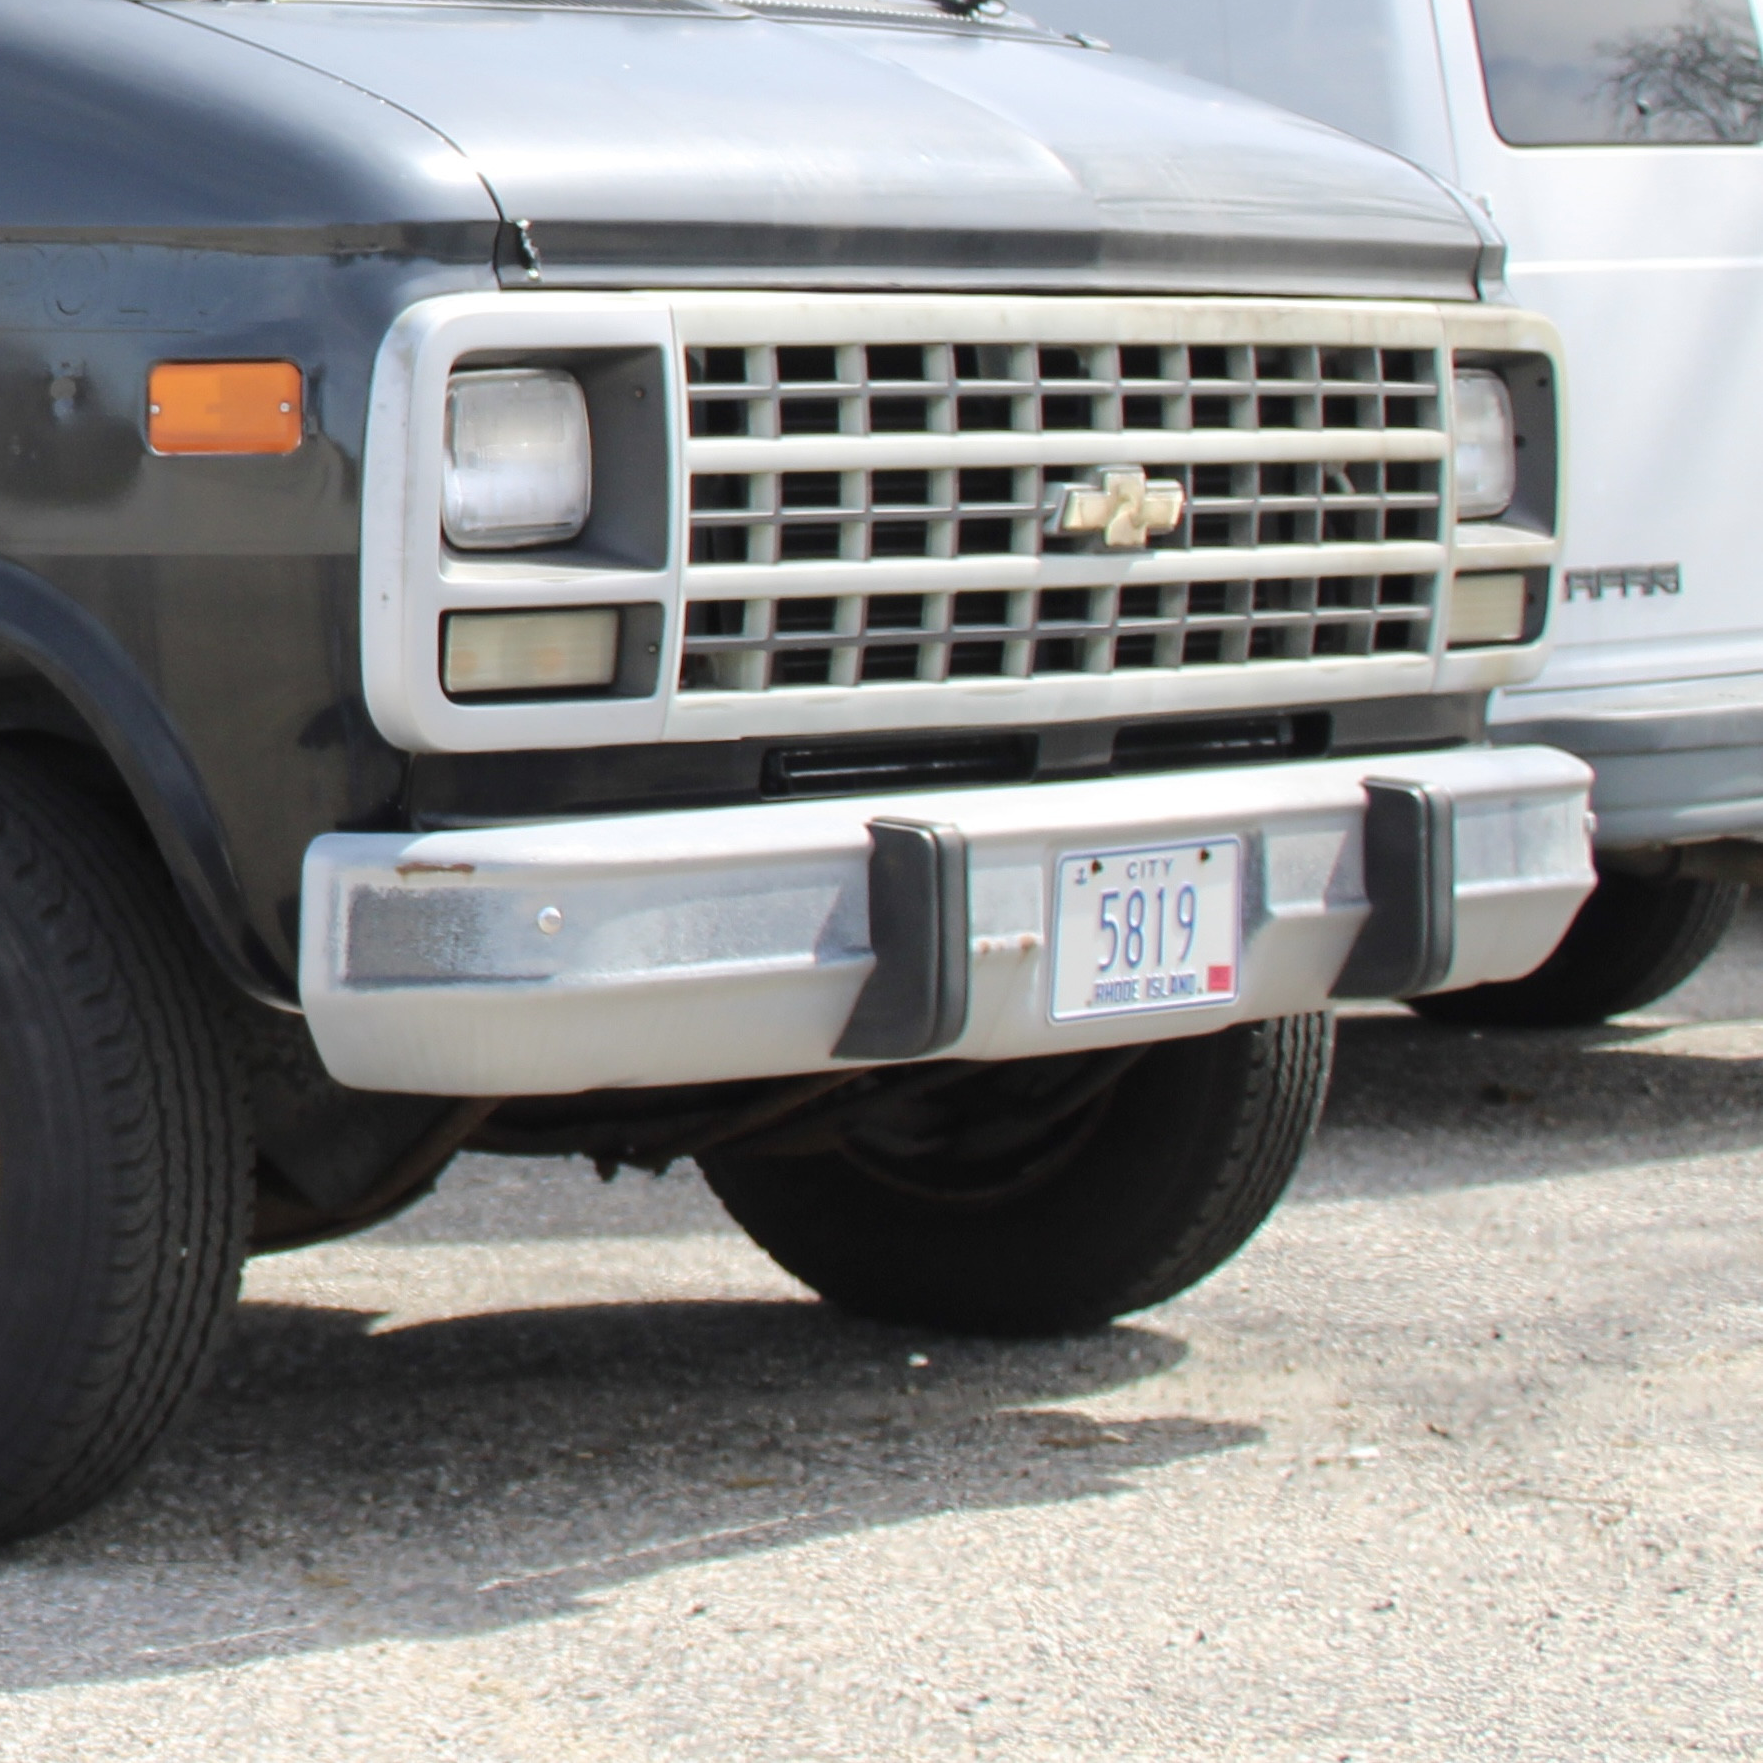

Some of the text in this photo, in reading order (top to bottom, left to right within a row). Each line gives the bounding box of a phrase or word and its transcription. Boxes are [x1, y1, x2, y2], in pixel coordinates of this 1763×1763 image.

[1127, 858, 1174, 879] CITY
[1098, 883, 1197, 972] 5819
[1094, 977, 1140, 1004] RHODE
